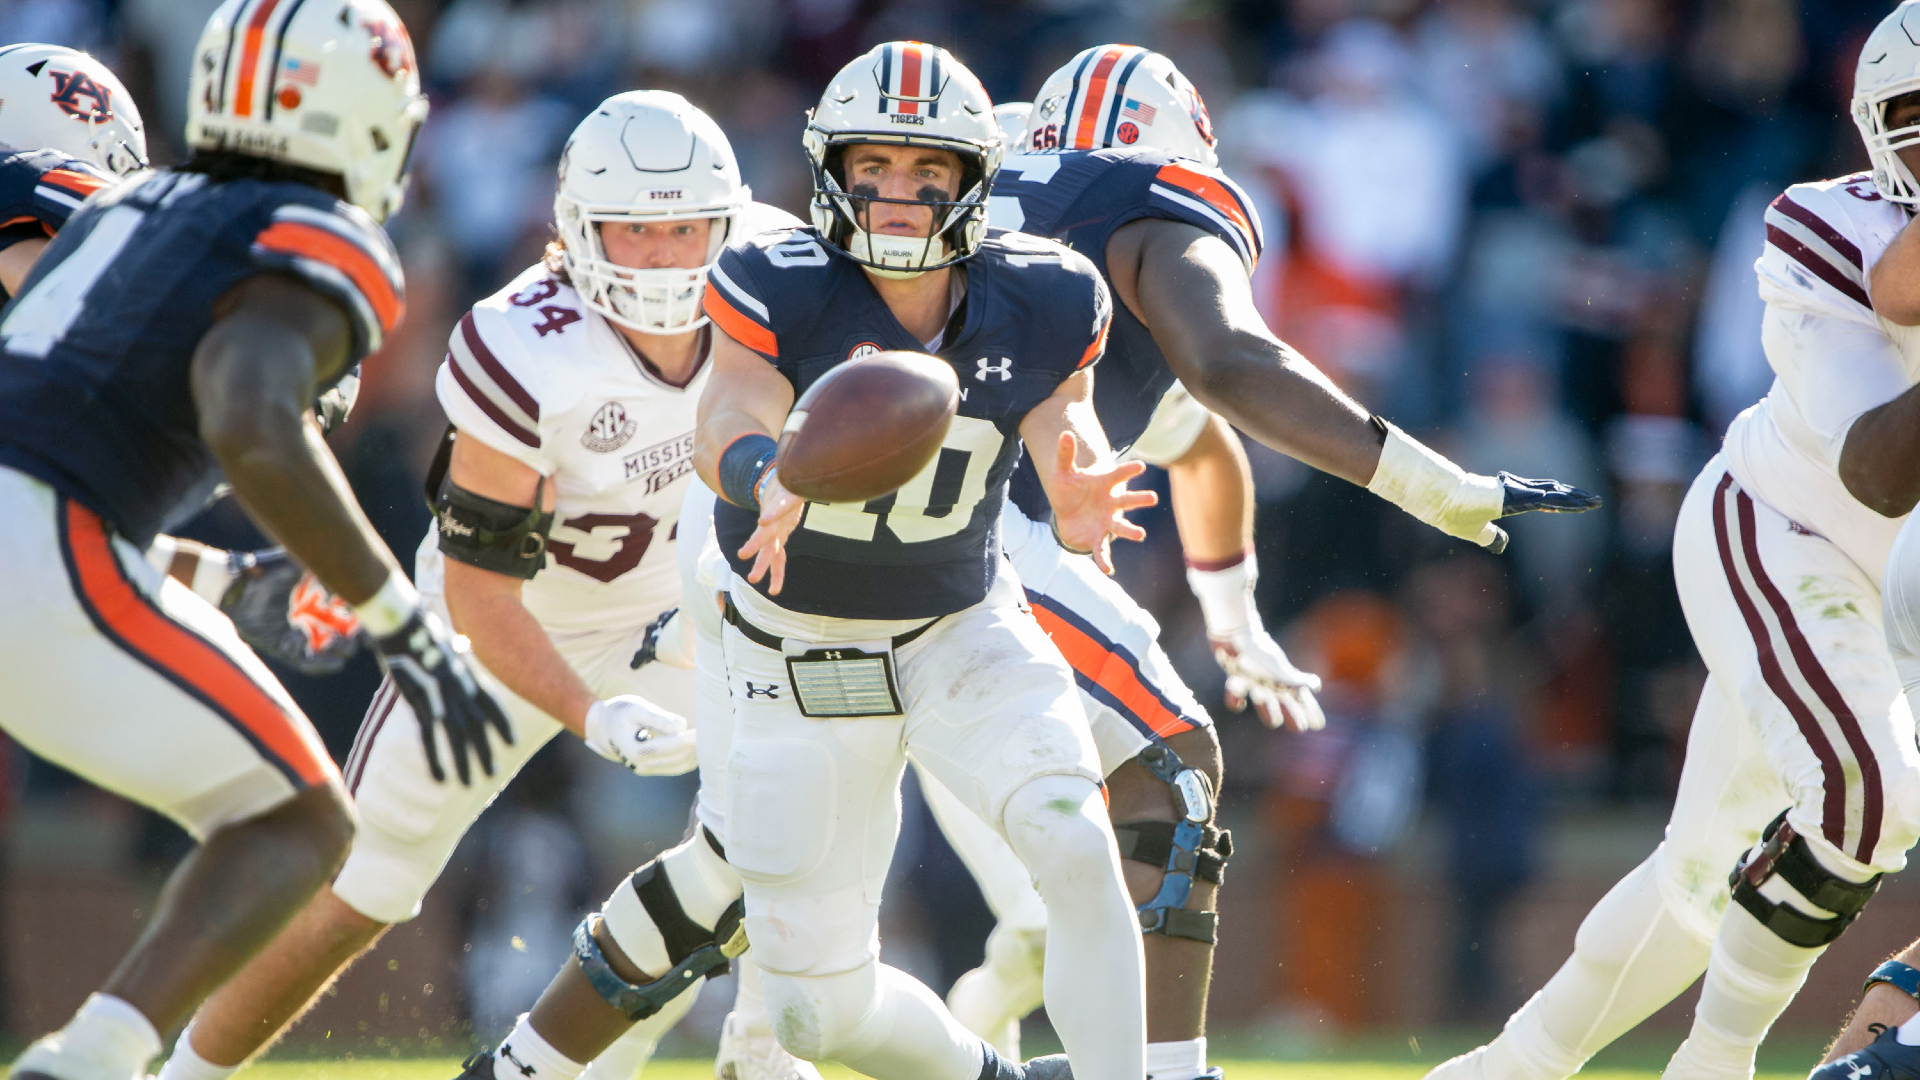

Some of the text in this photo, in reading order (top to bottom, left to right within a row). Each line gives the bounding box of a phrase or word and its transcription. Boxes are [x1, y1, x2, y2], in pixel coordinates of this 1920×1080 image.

[889, 113, 925, 125] TIGERS
[1033, 123, 1058, 149] 56
[1118, 125, 1139, 142] SEC
[649, 189, 683, 200] STATE
[882, 249, 913, 258] AUBURN
[507, 278, 583, 337] 34
[590, 404, 626, 440] SEC
